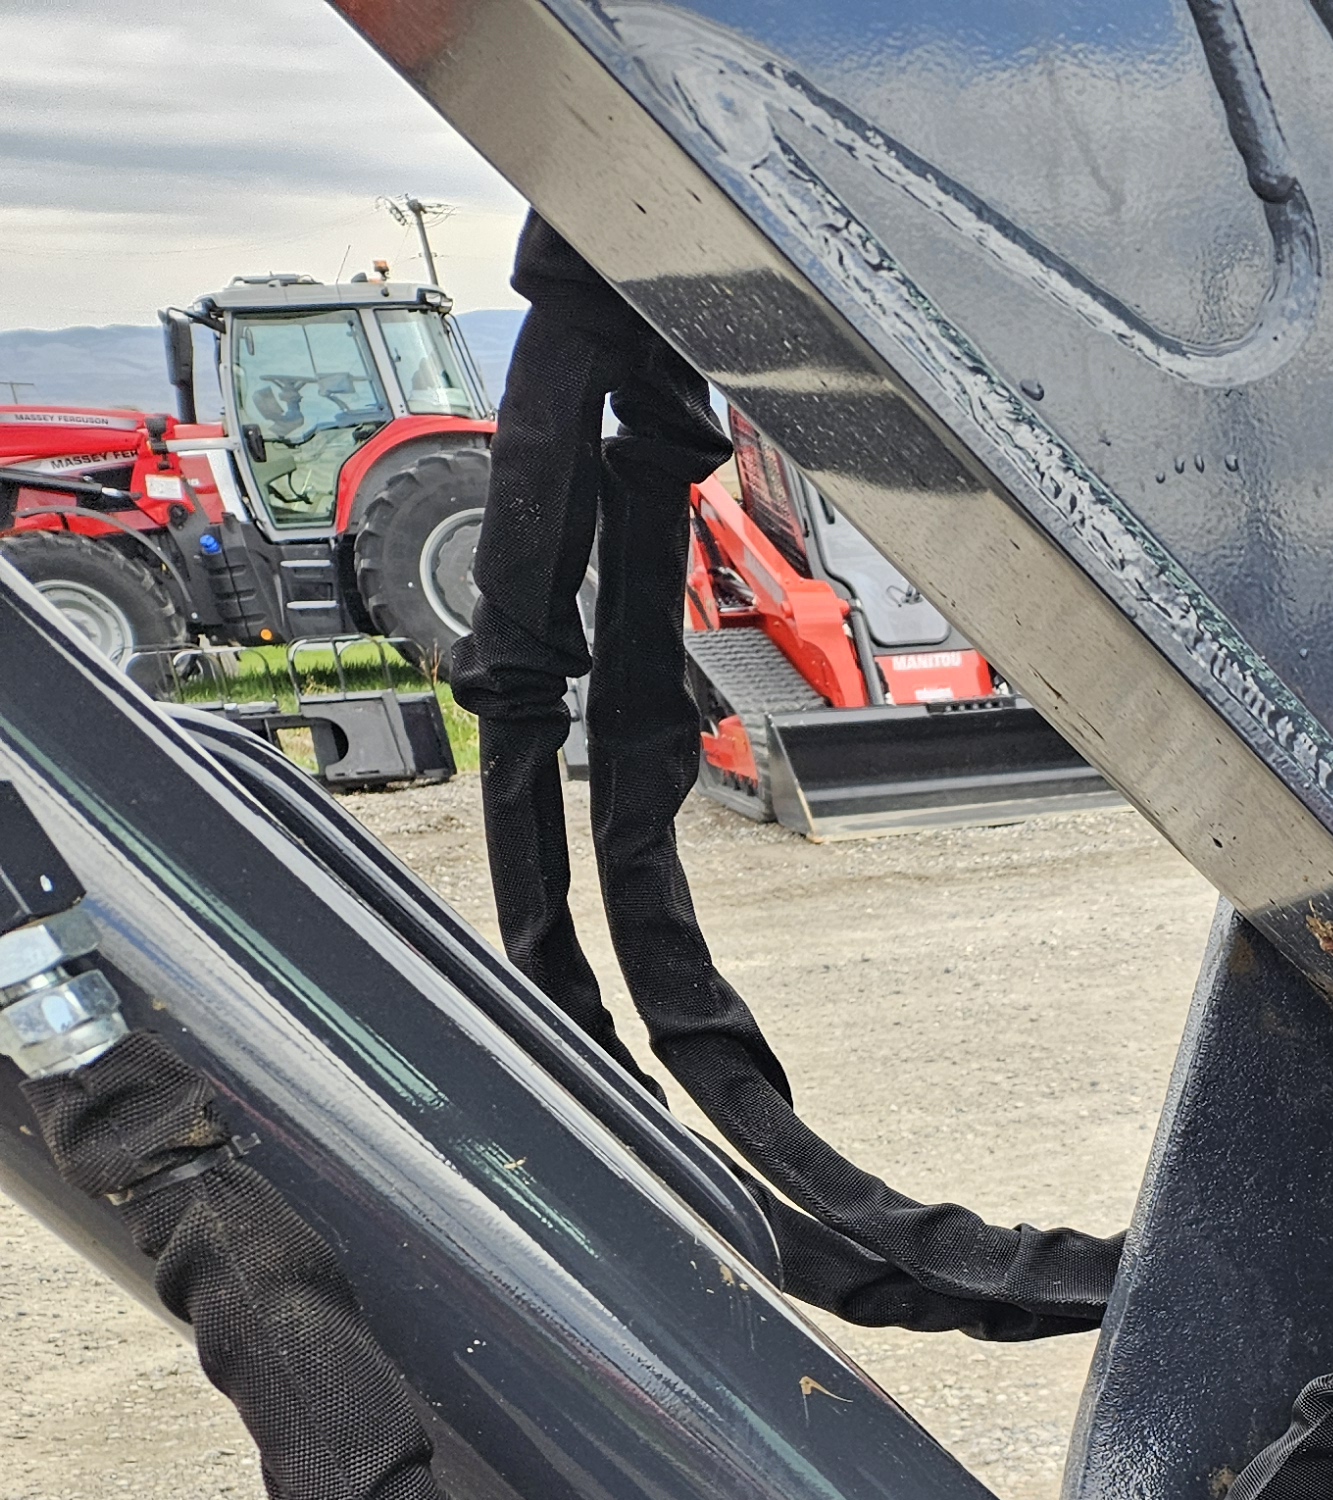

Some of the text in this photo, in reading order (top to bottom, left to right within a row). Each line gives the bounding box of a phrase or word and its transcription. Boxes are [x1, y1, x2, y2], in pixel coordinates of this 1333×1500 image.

[15, 414, 109, 425] MASSEY FERGUSON
[51, 453, 108, 469] MASSEY
[892, 651, 963, 671] MANITOU
